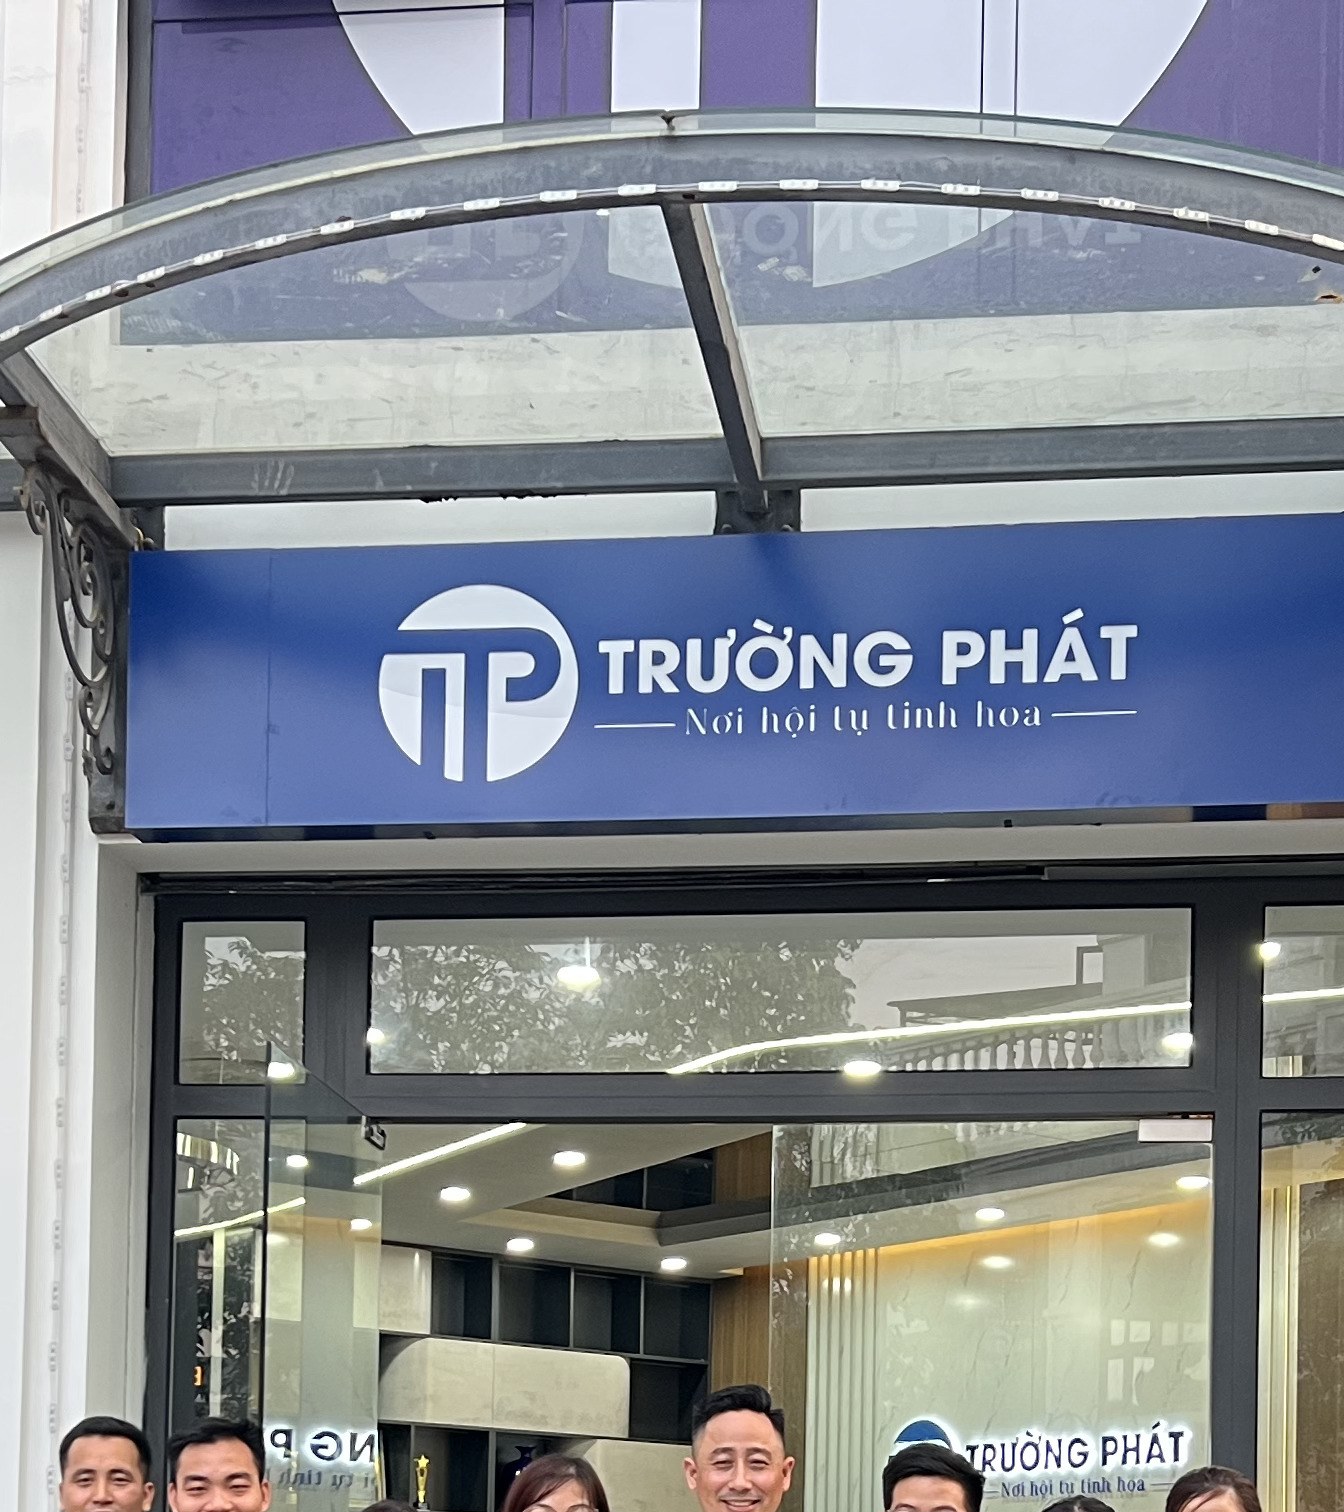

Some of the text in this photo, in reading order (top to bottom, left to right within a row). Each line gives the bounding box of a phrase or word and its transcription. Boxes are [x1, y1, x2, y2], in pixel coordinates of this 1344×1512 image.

[598, 618, 914, 694] TRƯỜNG
[942, 607, 1138, 685] PHÁT
[685, 699, 1042, 739] Nơi hội tụ tinh hoa
[965, 1421, 1185, 1473] TRƯỜNG PHÁT
[1001, 1481, 1026, 1498] Nơi
[1030, 1479, 1054, 1498] hội
